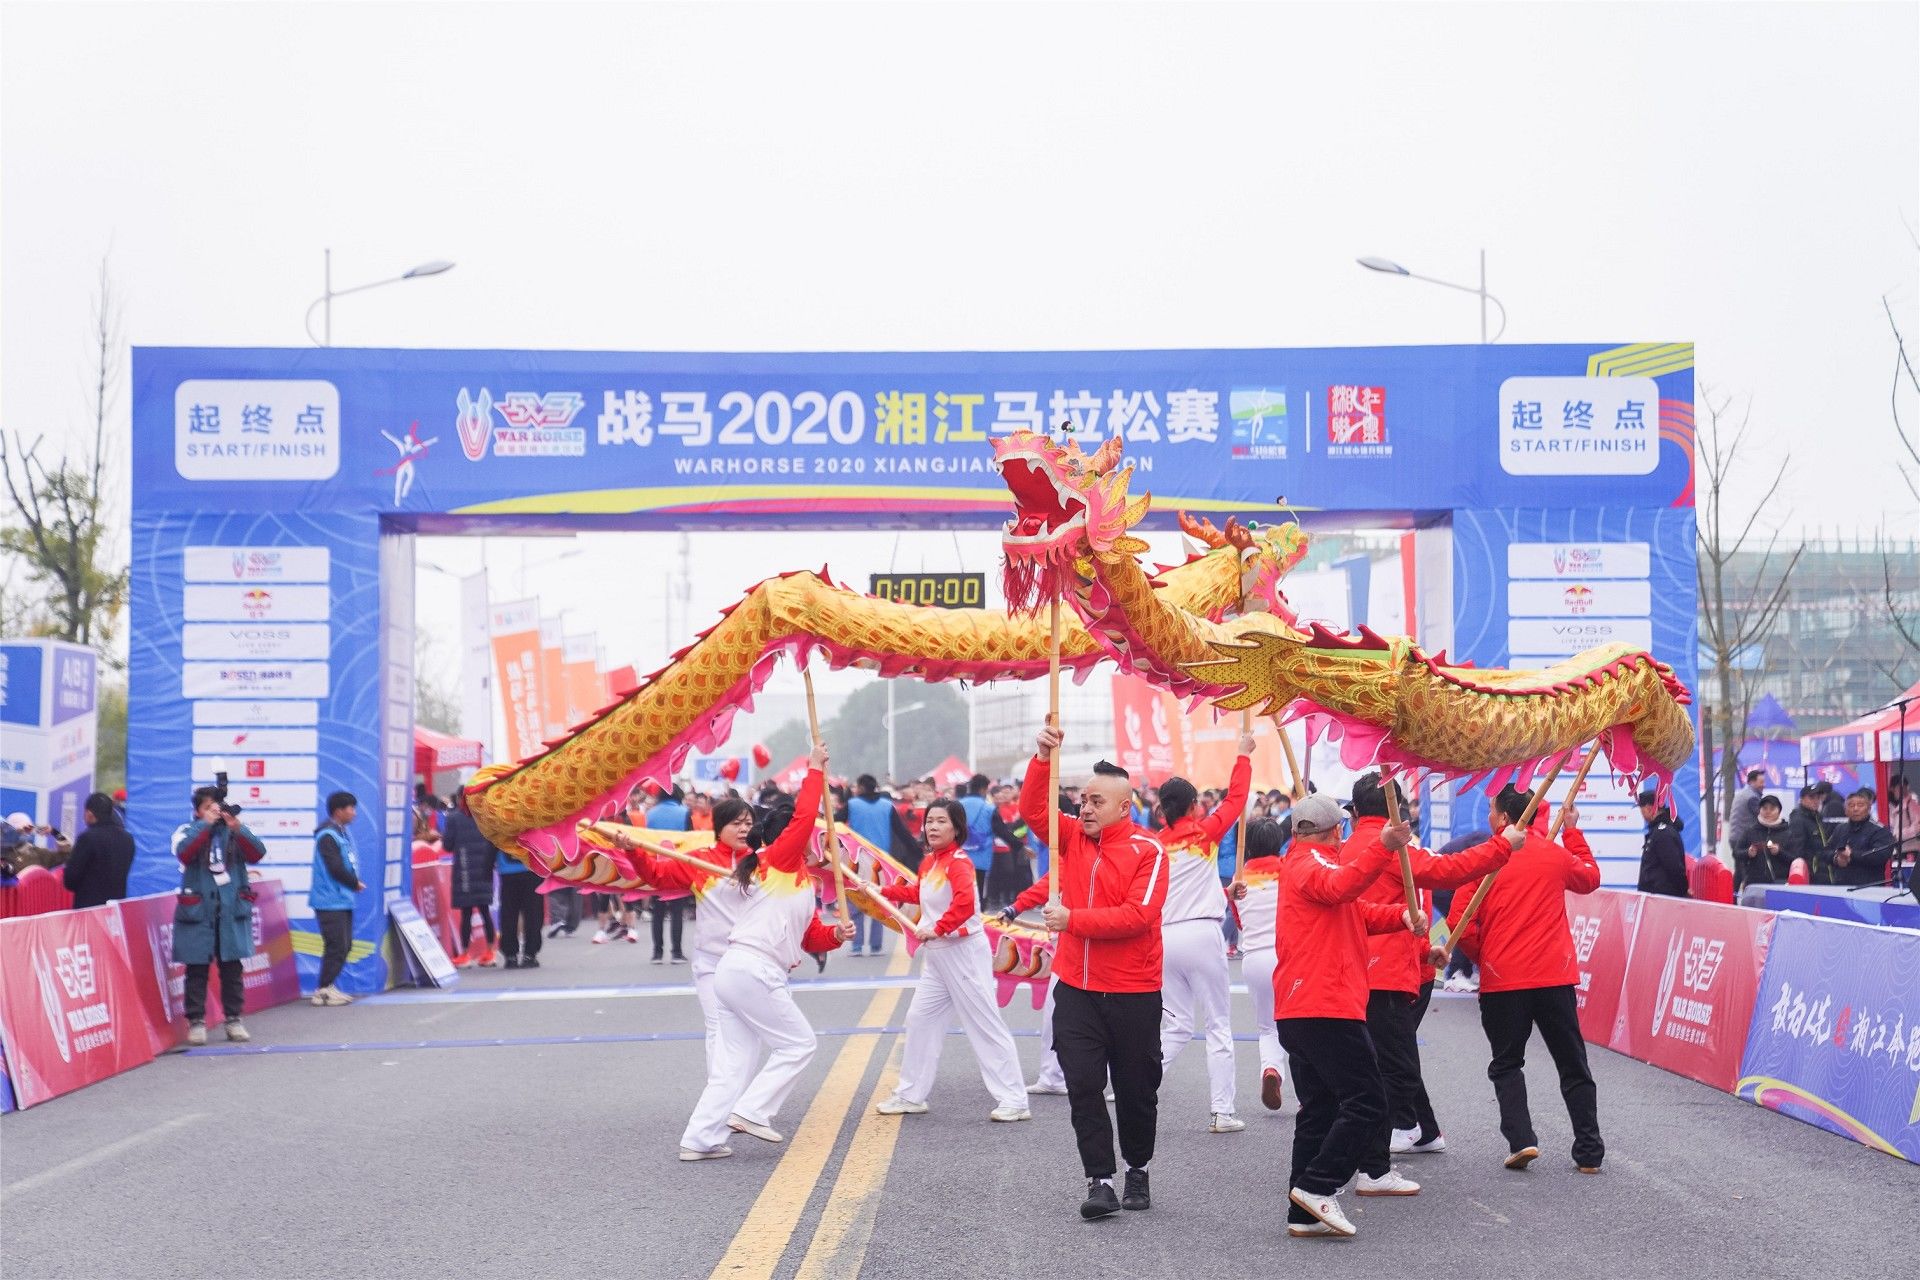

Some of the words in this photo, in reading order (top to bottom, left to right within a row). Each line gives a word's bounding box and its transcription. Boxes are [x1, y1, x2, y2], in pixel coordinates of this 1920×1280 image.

[189, 404, 325, 434] 起终点
[597, 389, 1220, 447] 战马2020湘江马拉松赛
[1511, 400, 1646, 431] 起终点
[497, 430, 529, 442] WAR
[532, 430, 583, 442] HORSE
[186, 443, 327, 457] START/FINISH
[1510, 438, 1647, 453] START/FINISH
[673, 457, 806, 475] WARHORSE
[813, 456, 867, 474] 2020
[873, 456, 998, 474] XIANGJIAN
[229, 631, 291, 640] VOSS
[1552, 625, 1613, 635] VOSS
